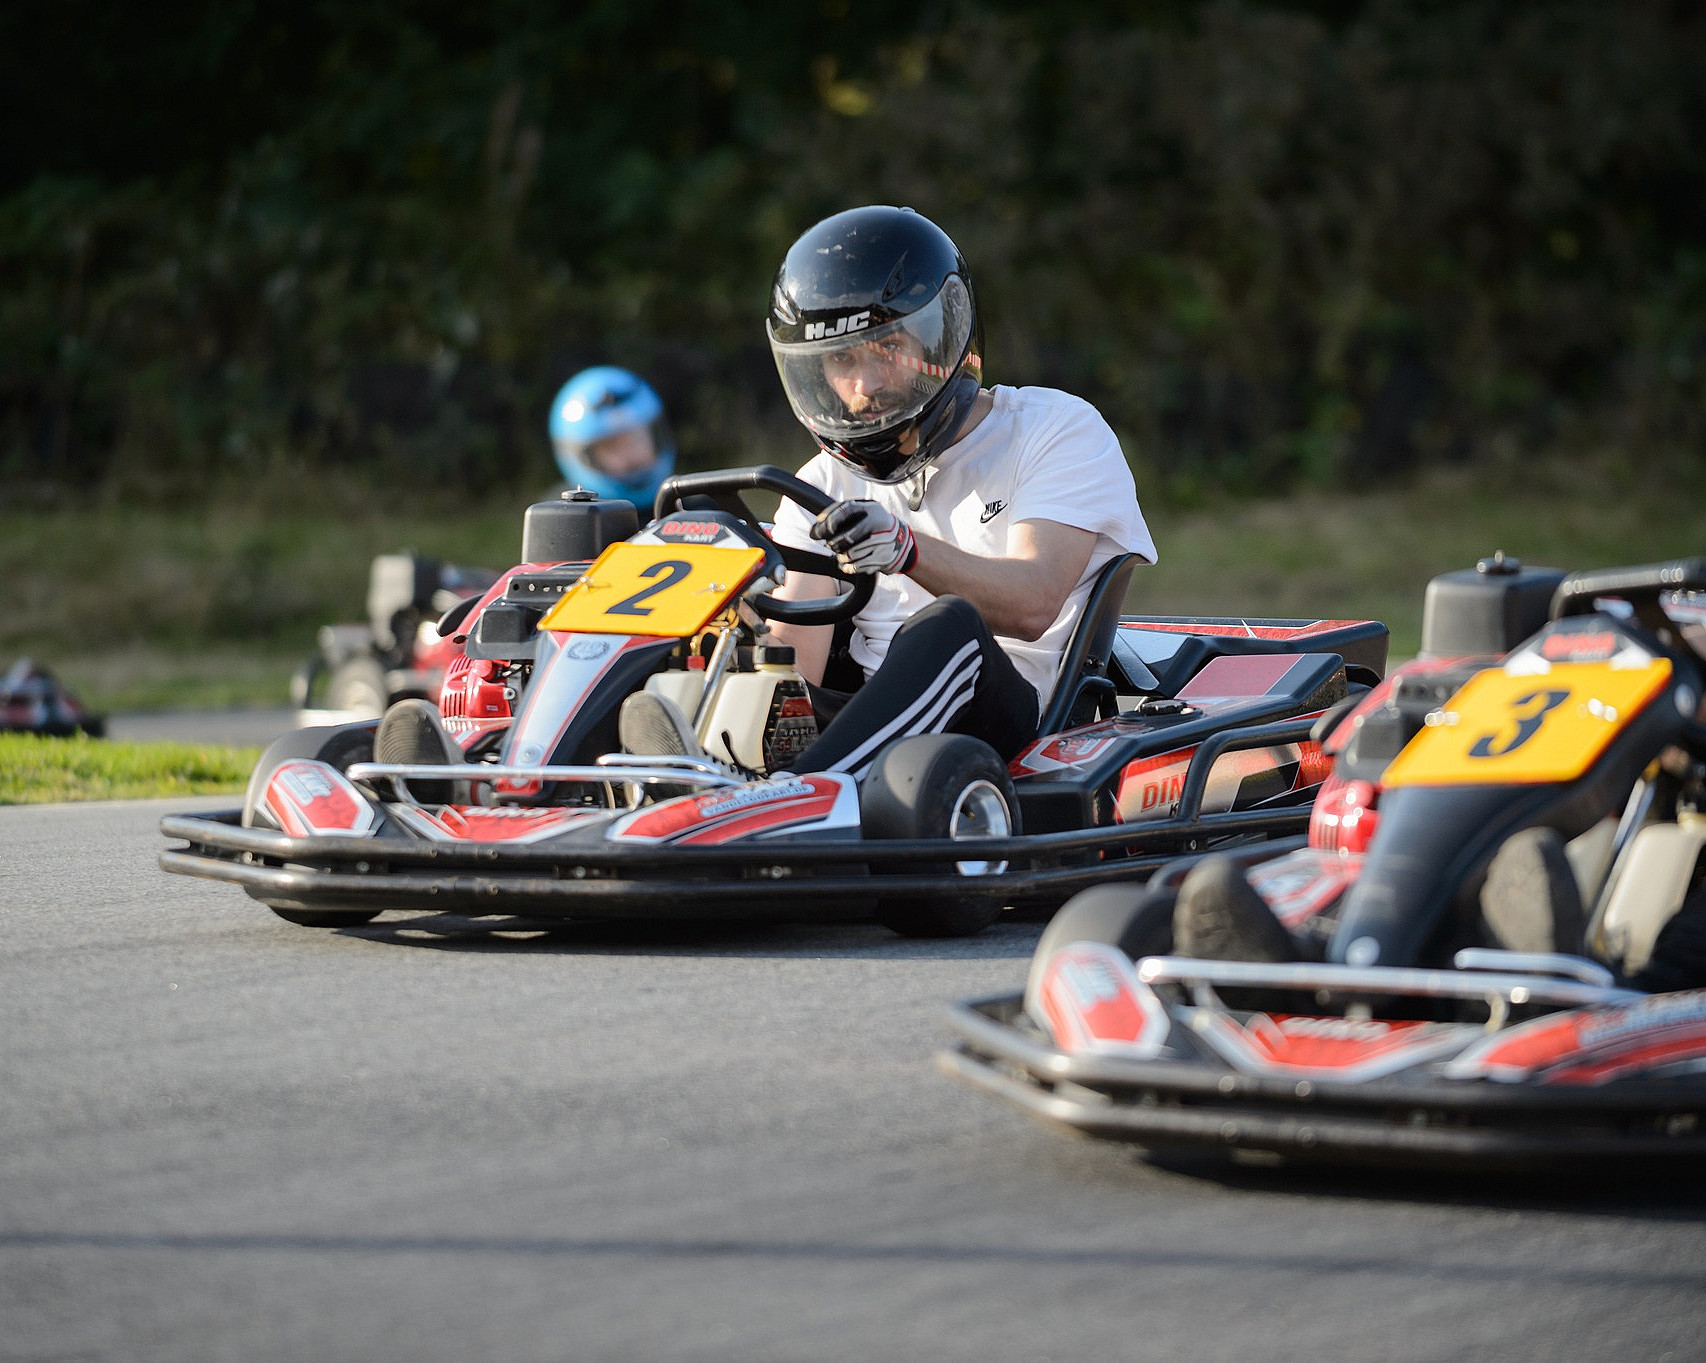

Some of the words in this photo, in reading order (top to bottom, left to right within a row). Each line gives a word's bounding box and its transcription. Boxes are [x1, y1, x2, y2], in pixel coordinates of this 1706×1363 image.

[805, 311, 870, 340] HJC
[984, 500, 1002, 515] NIKE
[662, 521, 720, 535] DINO
[684, 534, 716, 542] KART
[605, 560, 693, 616] 2
[1469, 691, 1571, 757] 3
[1141, 774, 1186, 812] DIN
